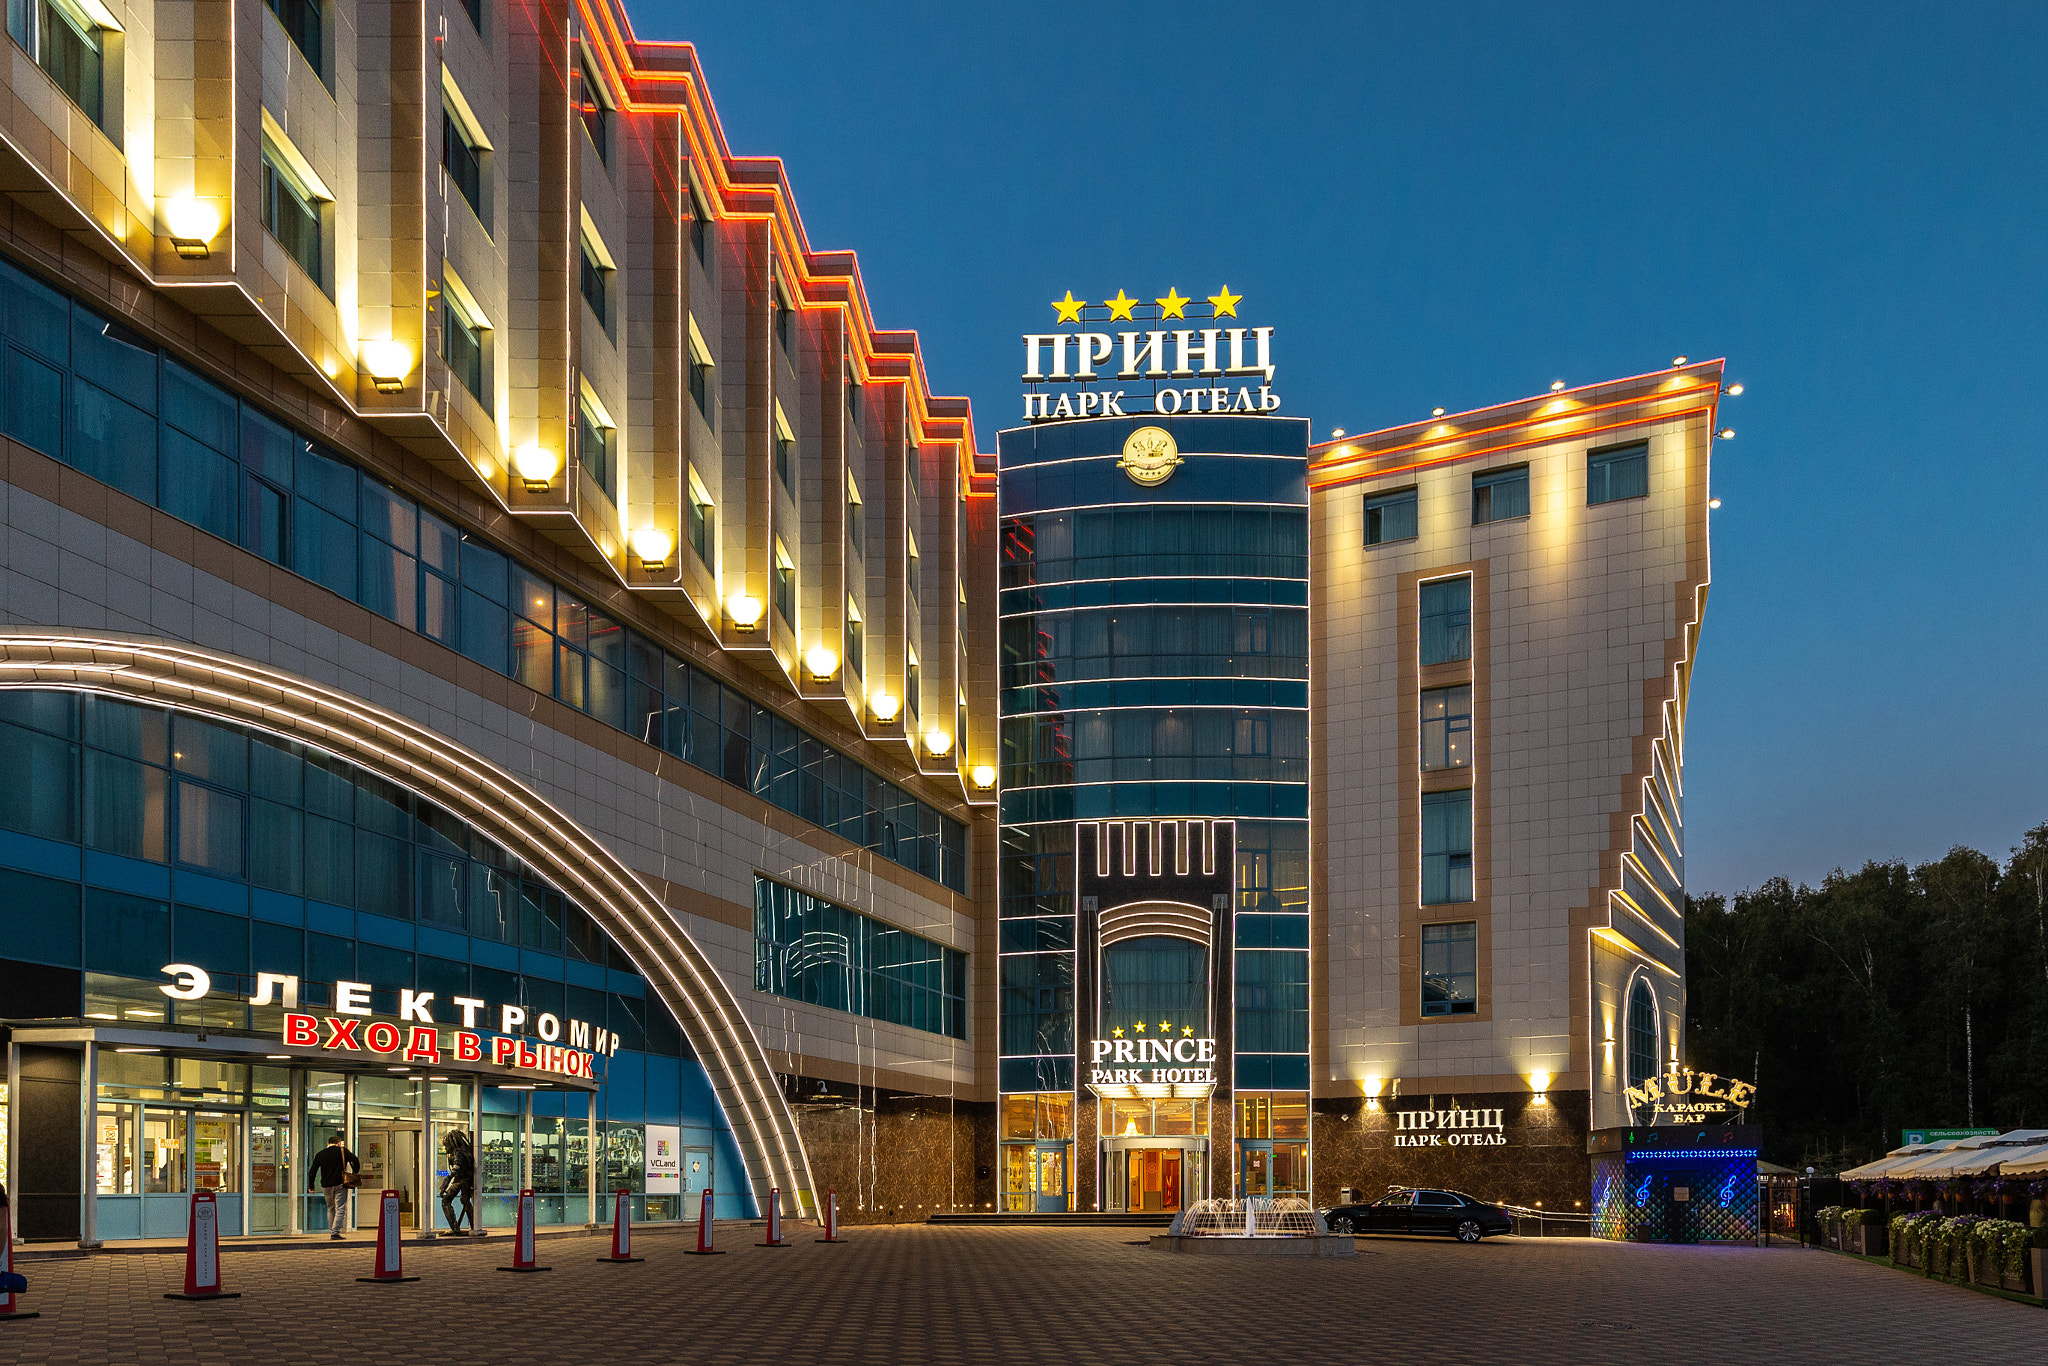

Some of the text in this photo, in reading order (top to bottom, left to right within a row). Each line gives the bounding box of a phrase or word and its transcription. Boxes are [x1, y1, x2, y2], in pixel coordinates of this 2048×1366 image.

[1022, 327, 1275, 386] ПРИНЦ
[1023, 385, 1281, 421] ПАРК ОТЕЛЬ
[158, 963, 620, 1058] ЭЛЕКТРОМИР
[283, 1013, 594, 1079] ВХОД В РЫНОК
[1090, 1038, 1217, 1063] PRINCE
[1091, 1067, 1217, 1084] PARK HOTEL
[1623, 1070, 1757, 1110] MULE
[1653, 1102, 1726, 1113] КАРАОКЕ
[1673, 1114, 1706, 1124] БАР
[1396, 1108, 1504, 1132] ПРИНЦ
[1393, 1133, 1507, 1147] ПАРК ОТЕЛЬ
[650, 1159, 676, 1168] VCLand
